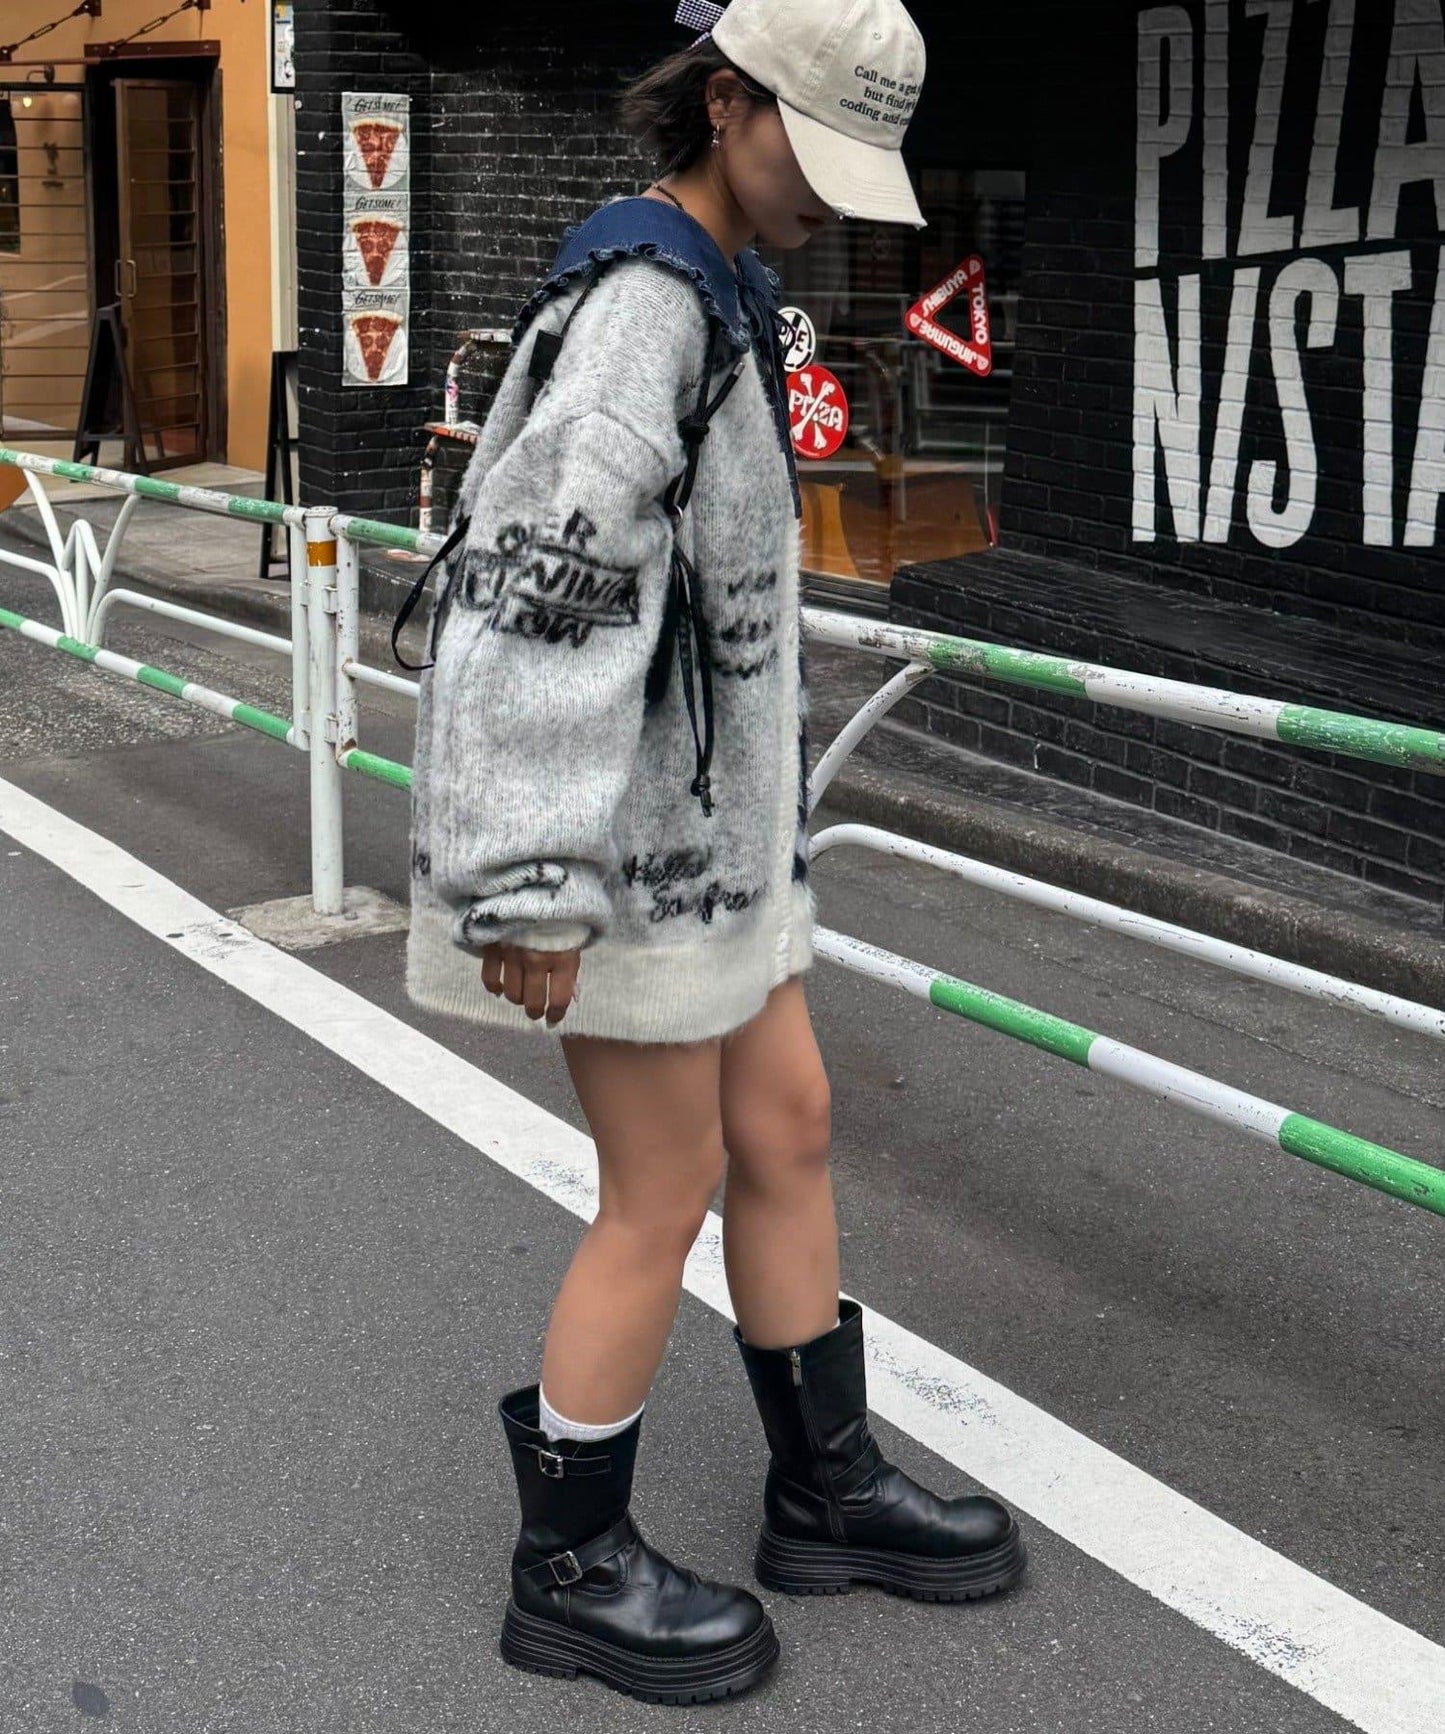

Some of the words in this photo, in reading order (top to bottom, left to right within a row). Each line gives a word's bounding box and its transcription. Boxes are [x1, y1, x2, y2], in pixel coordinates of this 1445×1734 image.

[854, 65, 878, 83] Call
[880, 76, 897, 90] me
[863, 86, 884, 103] but
[885, 94, 905, 110] find
[839, 98, 881, 121] coding
[1133, 0, 1445, 268] PIZZA
[922, 269, 968, 317] SHIBUYA
[972, 282, 988, 345] TOKYO
[919, 319, 977, 364] JINGUMAE
